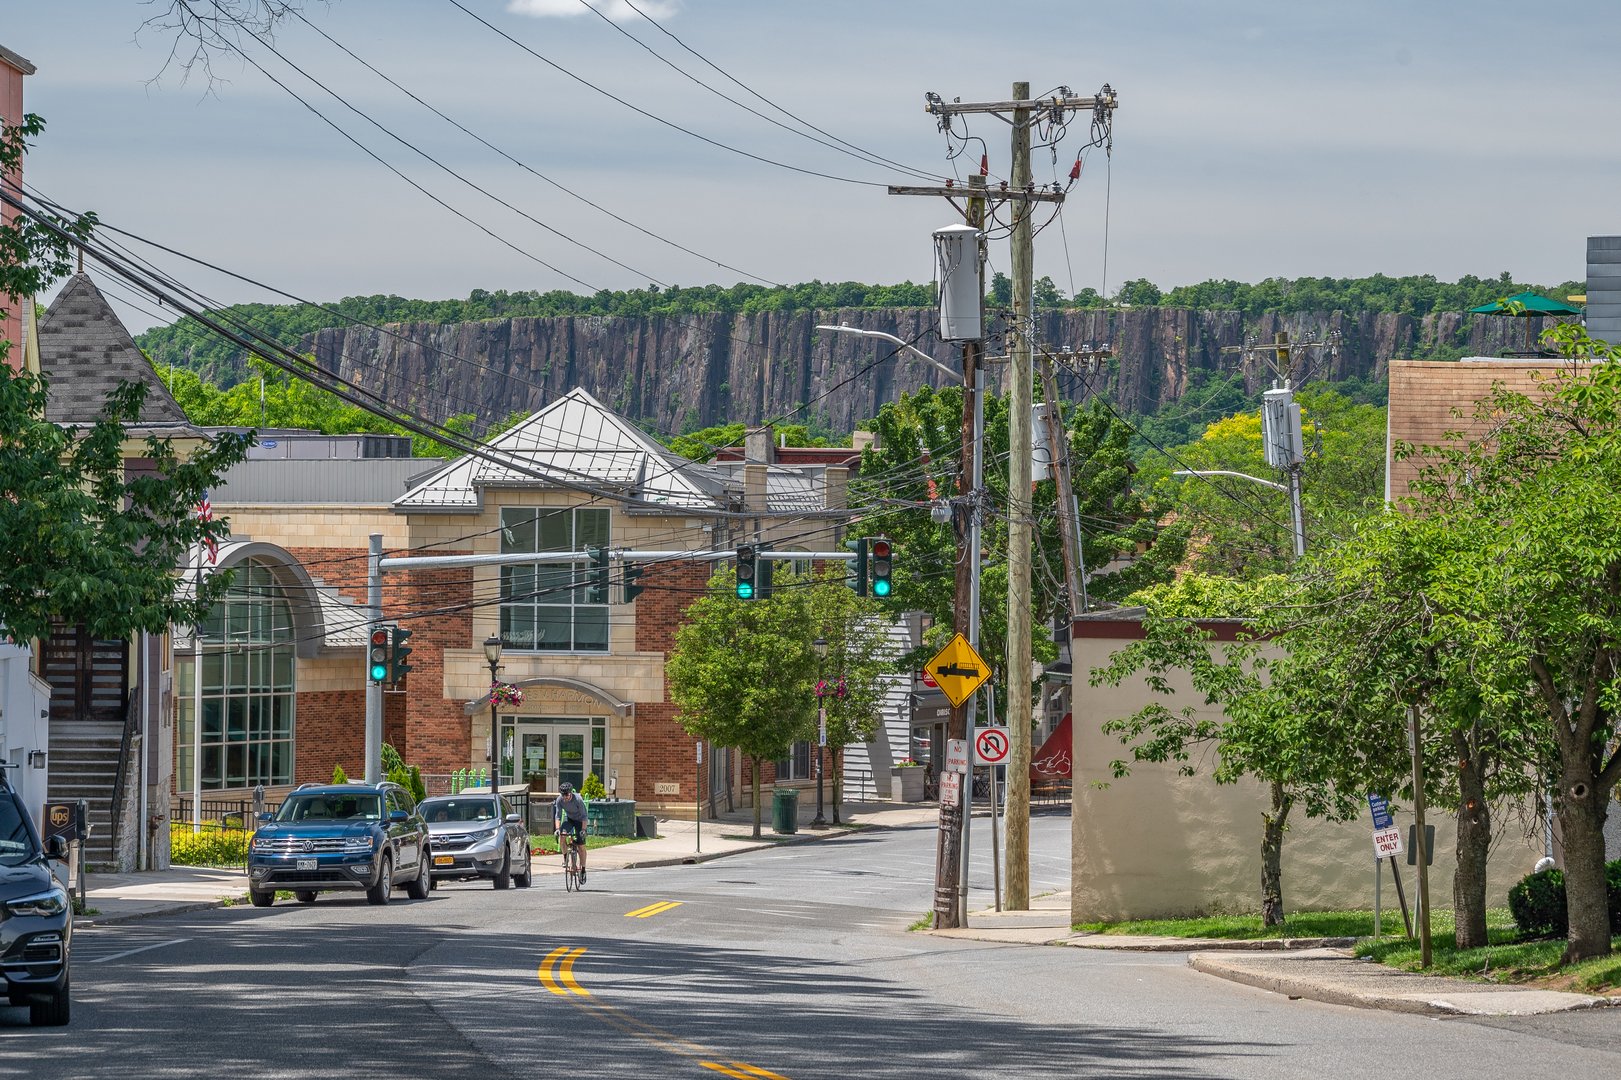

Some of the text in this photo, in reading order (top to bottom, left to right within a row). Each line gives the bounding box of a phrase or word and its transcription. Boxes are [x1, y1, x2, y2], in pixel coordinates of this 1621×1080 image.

[947, 758, 967, 766] PARKING
[659, 784, 676, 793] 2007
[52, 812, 68, 825] ups
[1375, 832, 1399, 844] ENTER
[1380, 841, 1398, 852] ONLY
